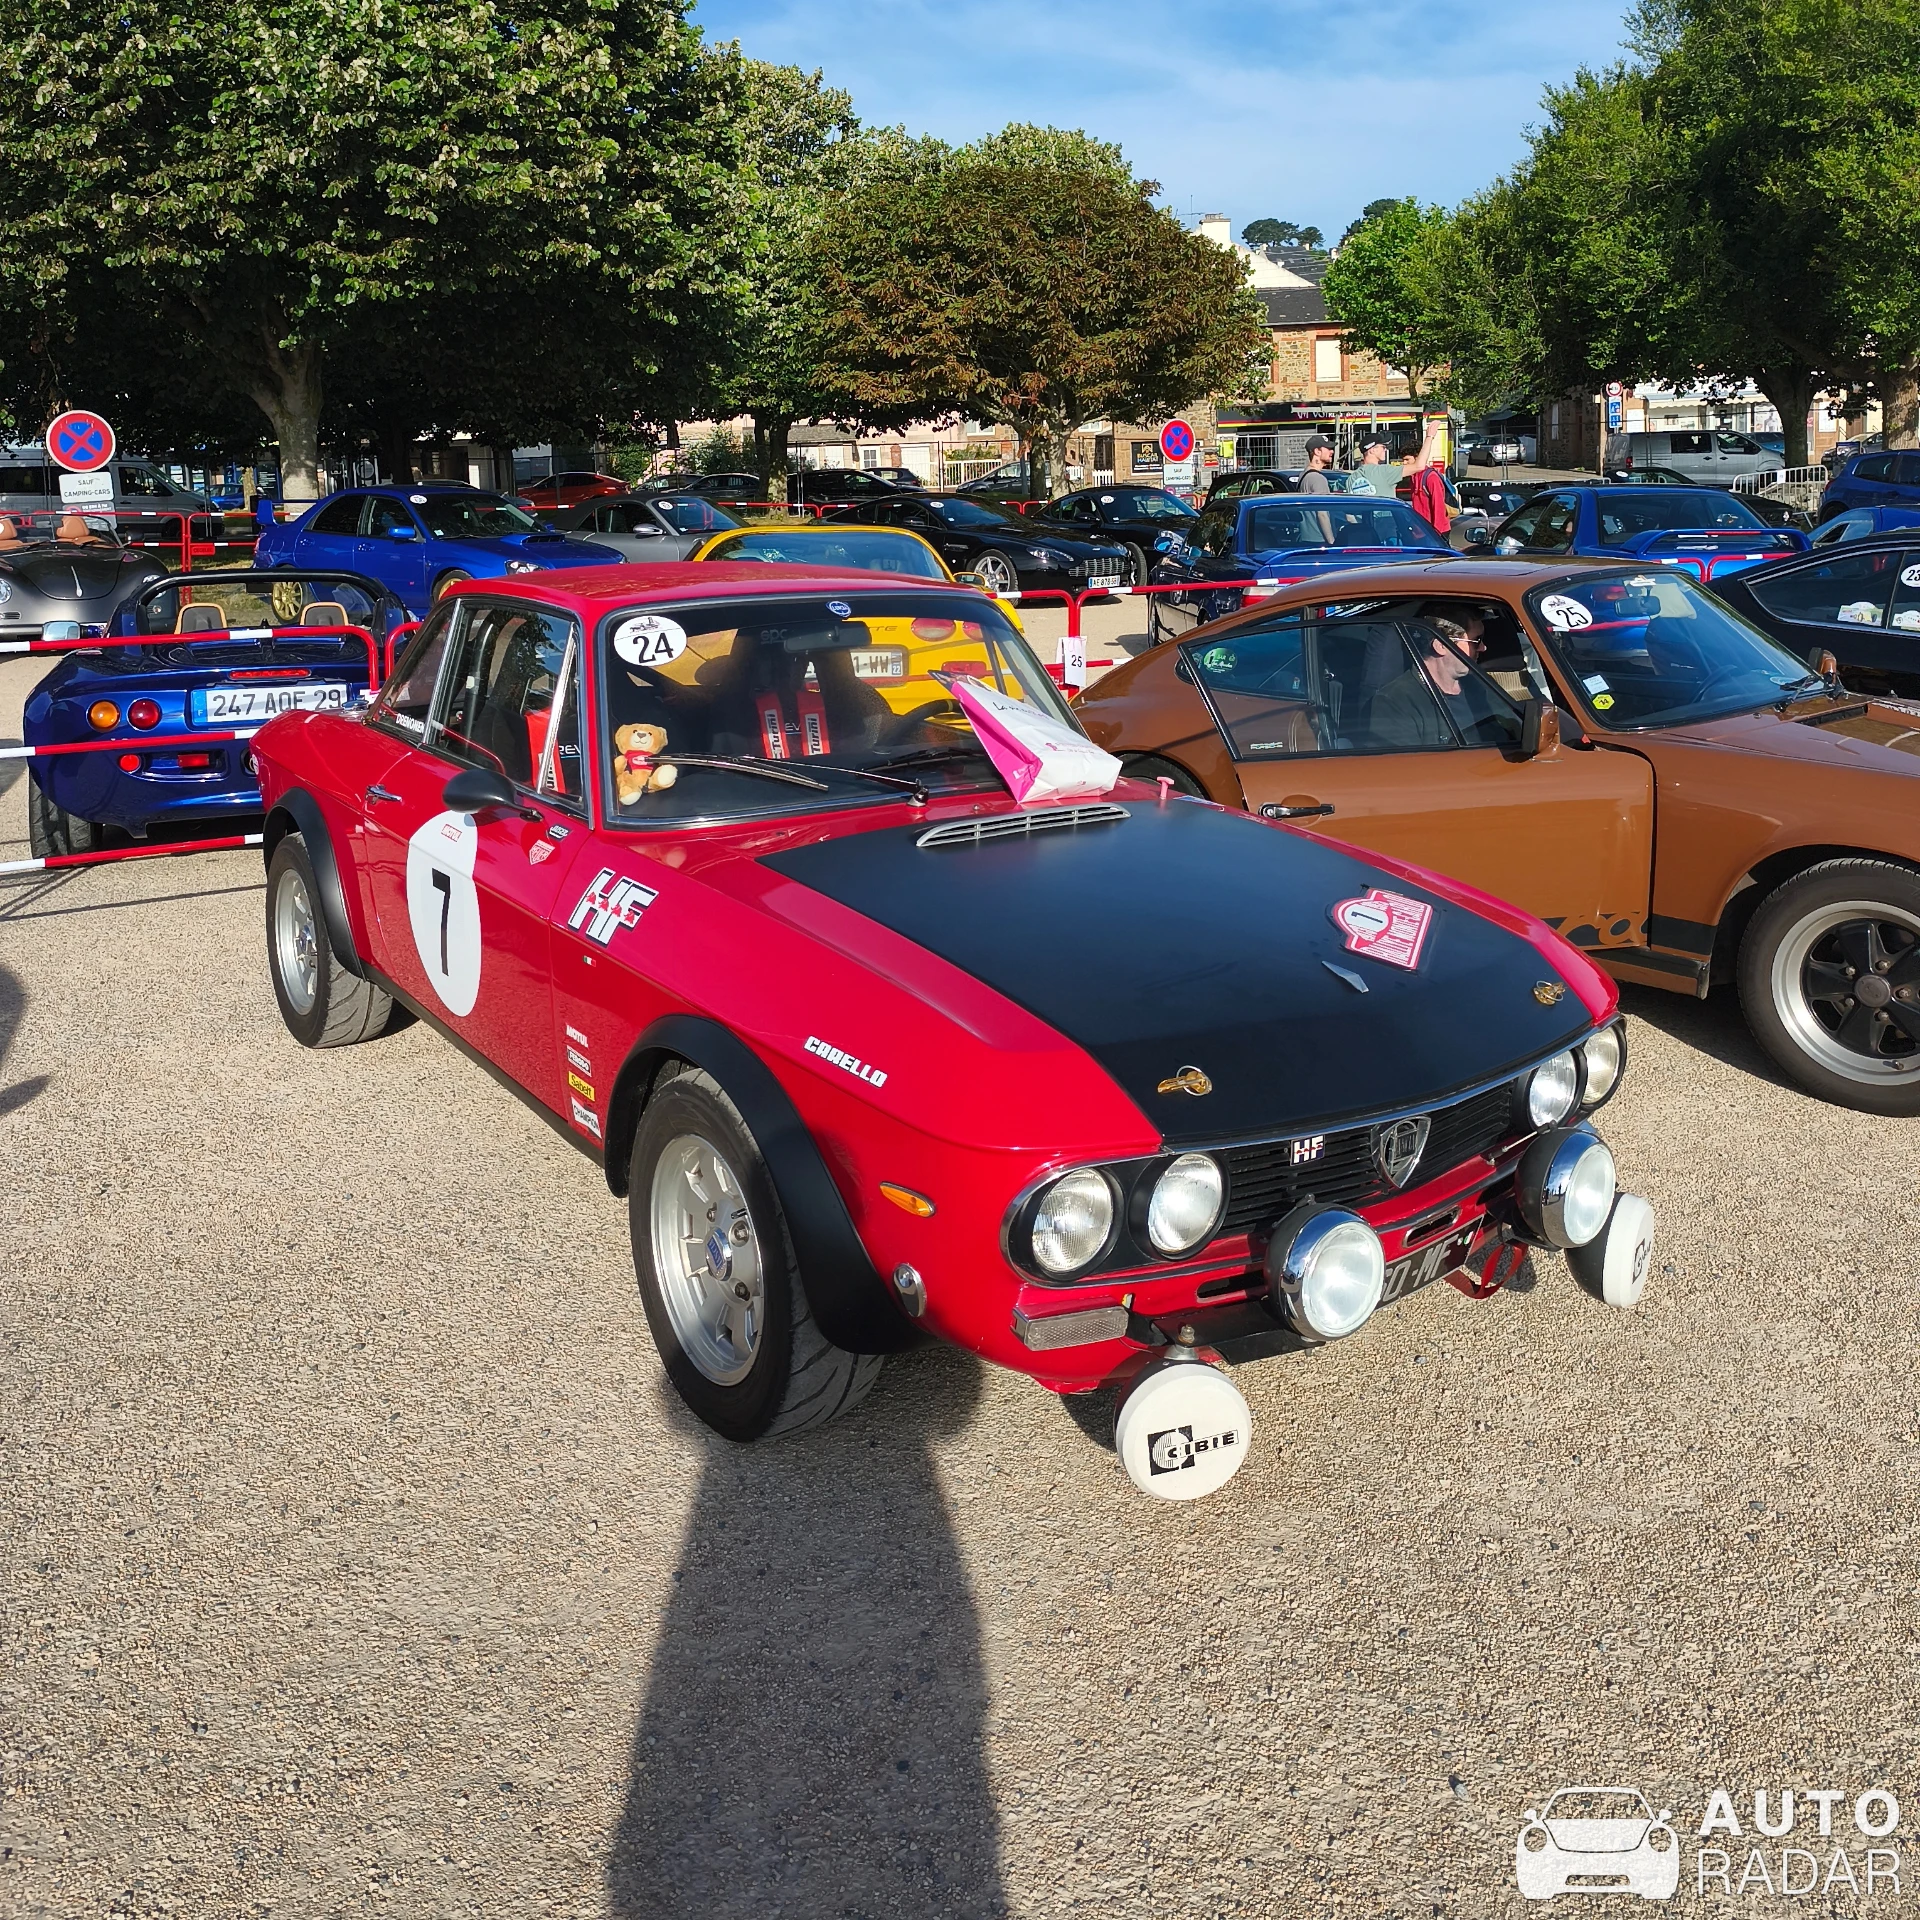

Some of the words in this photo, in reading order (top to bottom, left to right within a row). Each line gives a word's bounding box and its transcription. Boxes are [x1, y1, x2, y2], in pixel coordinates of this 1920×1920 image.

[63, 488, 111, 498] CAMPING-CARS
[1556, 606, 1589, 627] 25
[633, 632, 674, 664] 24
[1071, 654, 1083, 667] 25
[892, 665, 901, 674] 22
[212, 693, 257, 717] 247
[313, 689, 343, 711] 29
[766, 713, 782, 751] Turini
[807, 717, 822, 754] Turini
[568, 867, 660, 948] HF
[1350, 910, 1384, 925] 1
[431, 867, 452, 977] 7
[803, 1035, 888, 1088] CARELLO
[571, 1074, 593, 1099] Sabelt
[1293, 1135, 1325, 1164] HF
